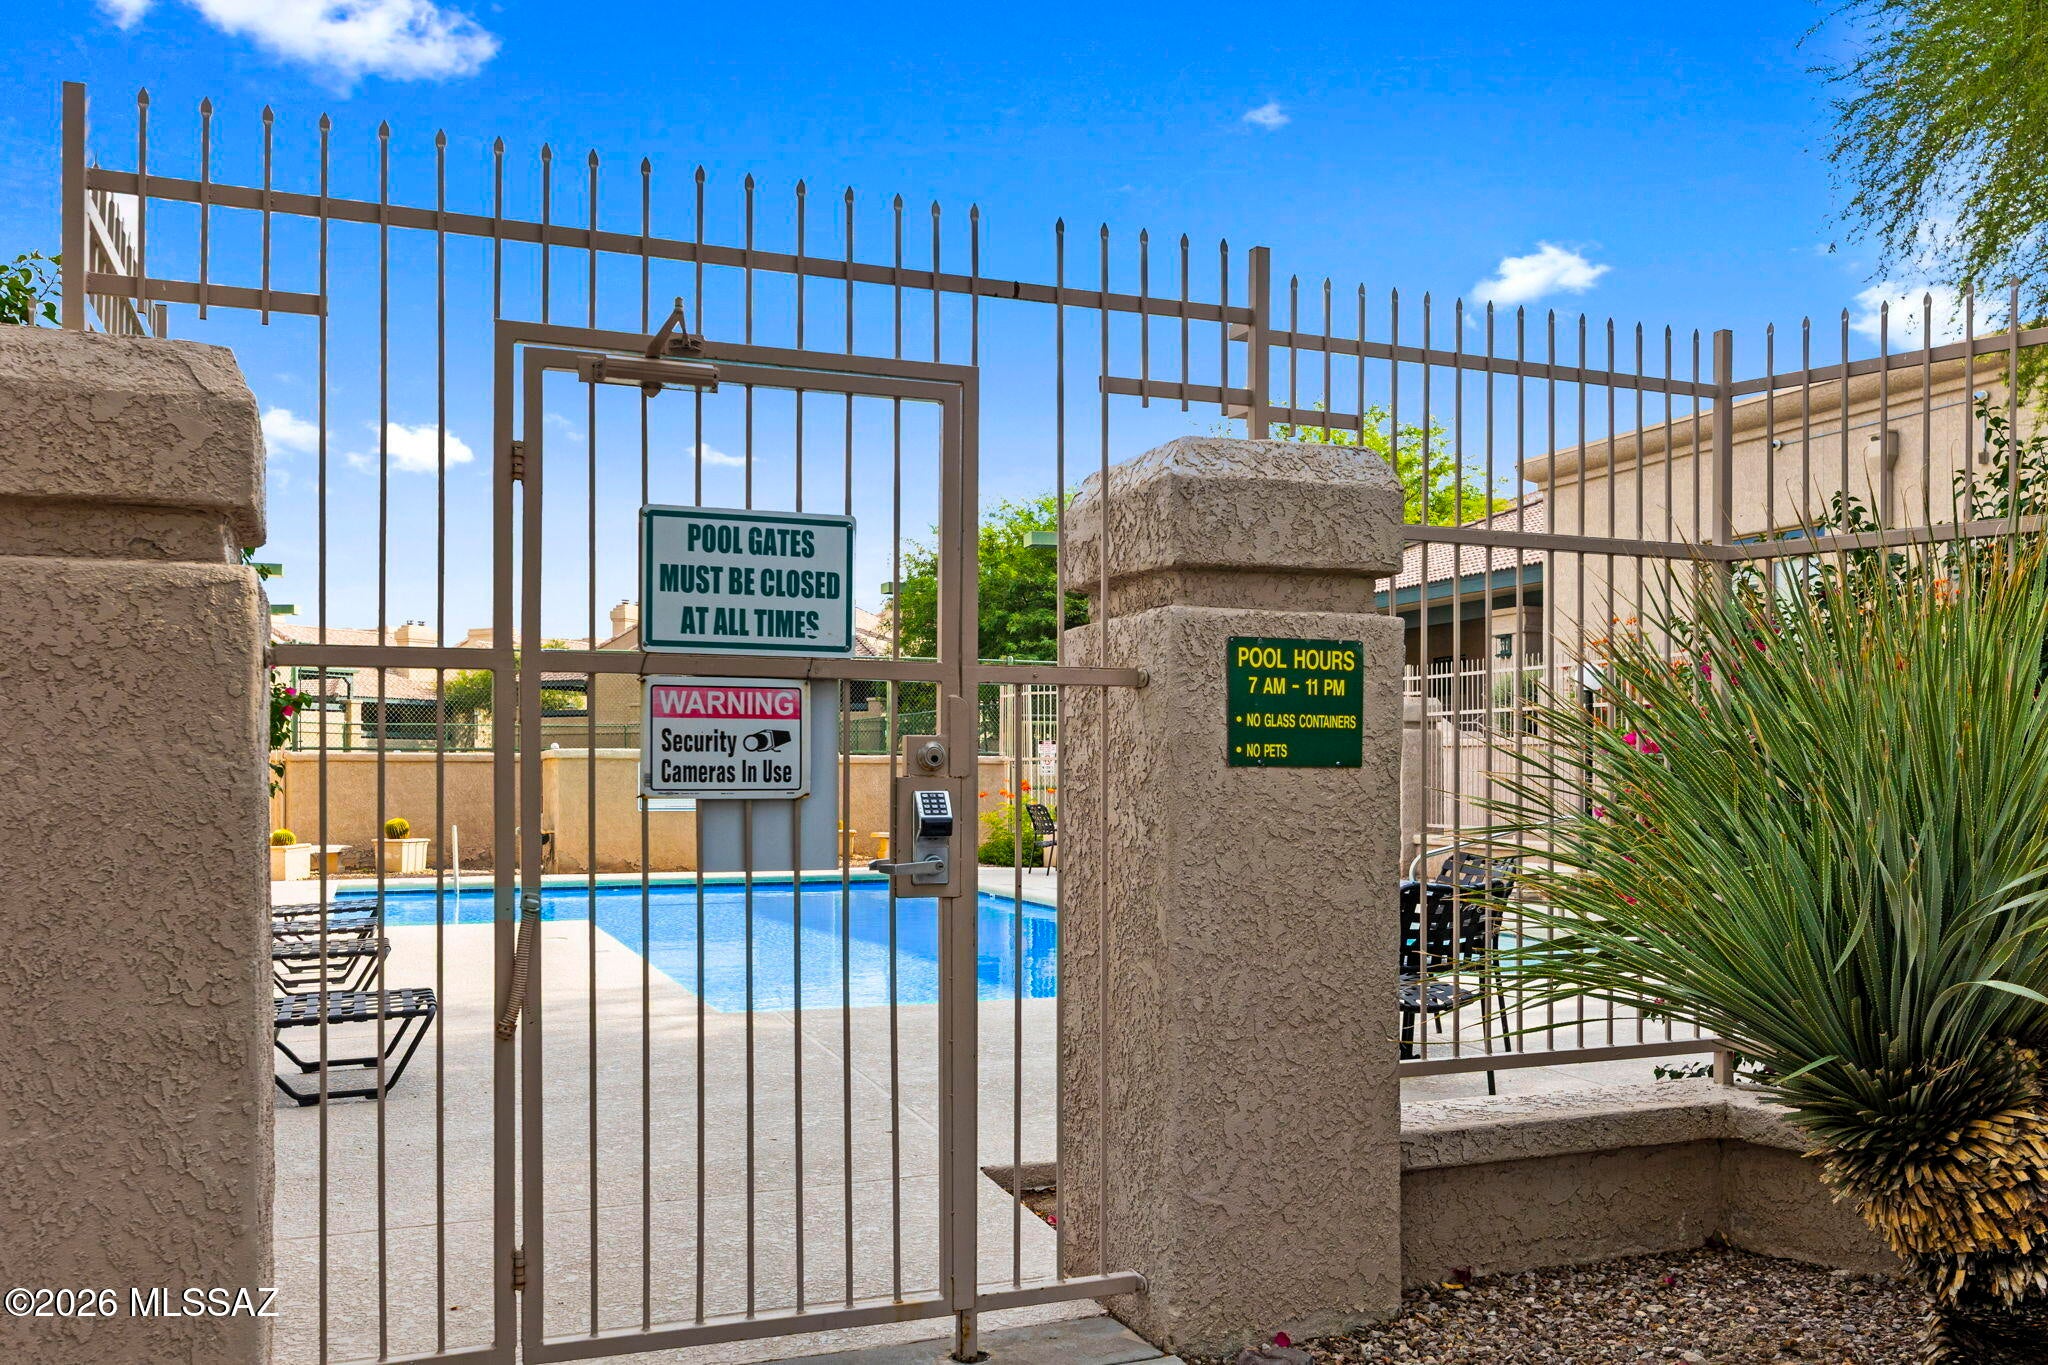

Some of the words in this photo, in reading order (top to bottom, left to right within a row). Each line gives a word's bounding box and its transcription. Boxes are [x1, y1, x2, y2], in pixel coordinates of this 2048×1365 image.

[688, 523, 743, 554] POOL
[748, 526, 814, 558] GATES
[659, 564, 723, 594] MUST
[728, 567, 754, 595] BE
[760, 568, 840, 599] CLOSED
[680, 606, 708, 634] AT
[713, 607, 749, 636] ALL
[754, 609, 820, 639] TIMES
[1237, 646, 1287, 669] POOL
[1294, 649, 1355, 671] HOURS
[1248, 676, 1258, 693] 7
[1263, 677, 1286, 694] AM
[1305, 678, 1318, 696] 11
[1324, 679, 1345, 696] PM
[658, 690, 794, 715] WARNING
[1246, 713, 1261, 727] NO
[1264, 714, 1296, 728] GLASS
[1299, 715, 1357, 729] CONTAINERS
[661, 727, 737, 757] Security
[1246, 743, 1261, 757] NO
[1264, 744, 1288, 758] PETS
[661, 758, 735, 783] Cameras
[742, 760, 757, 783] In
[763, 760, 792, 783] Use
